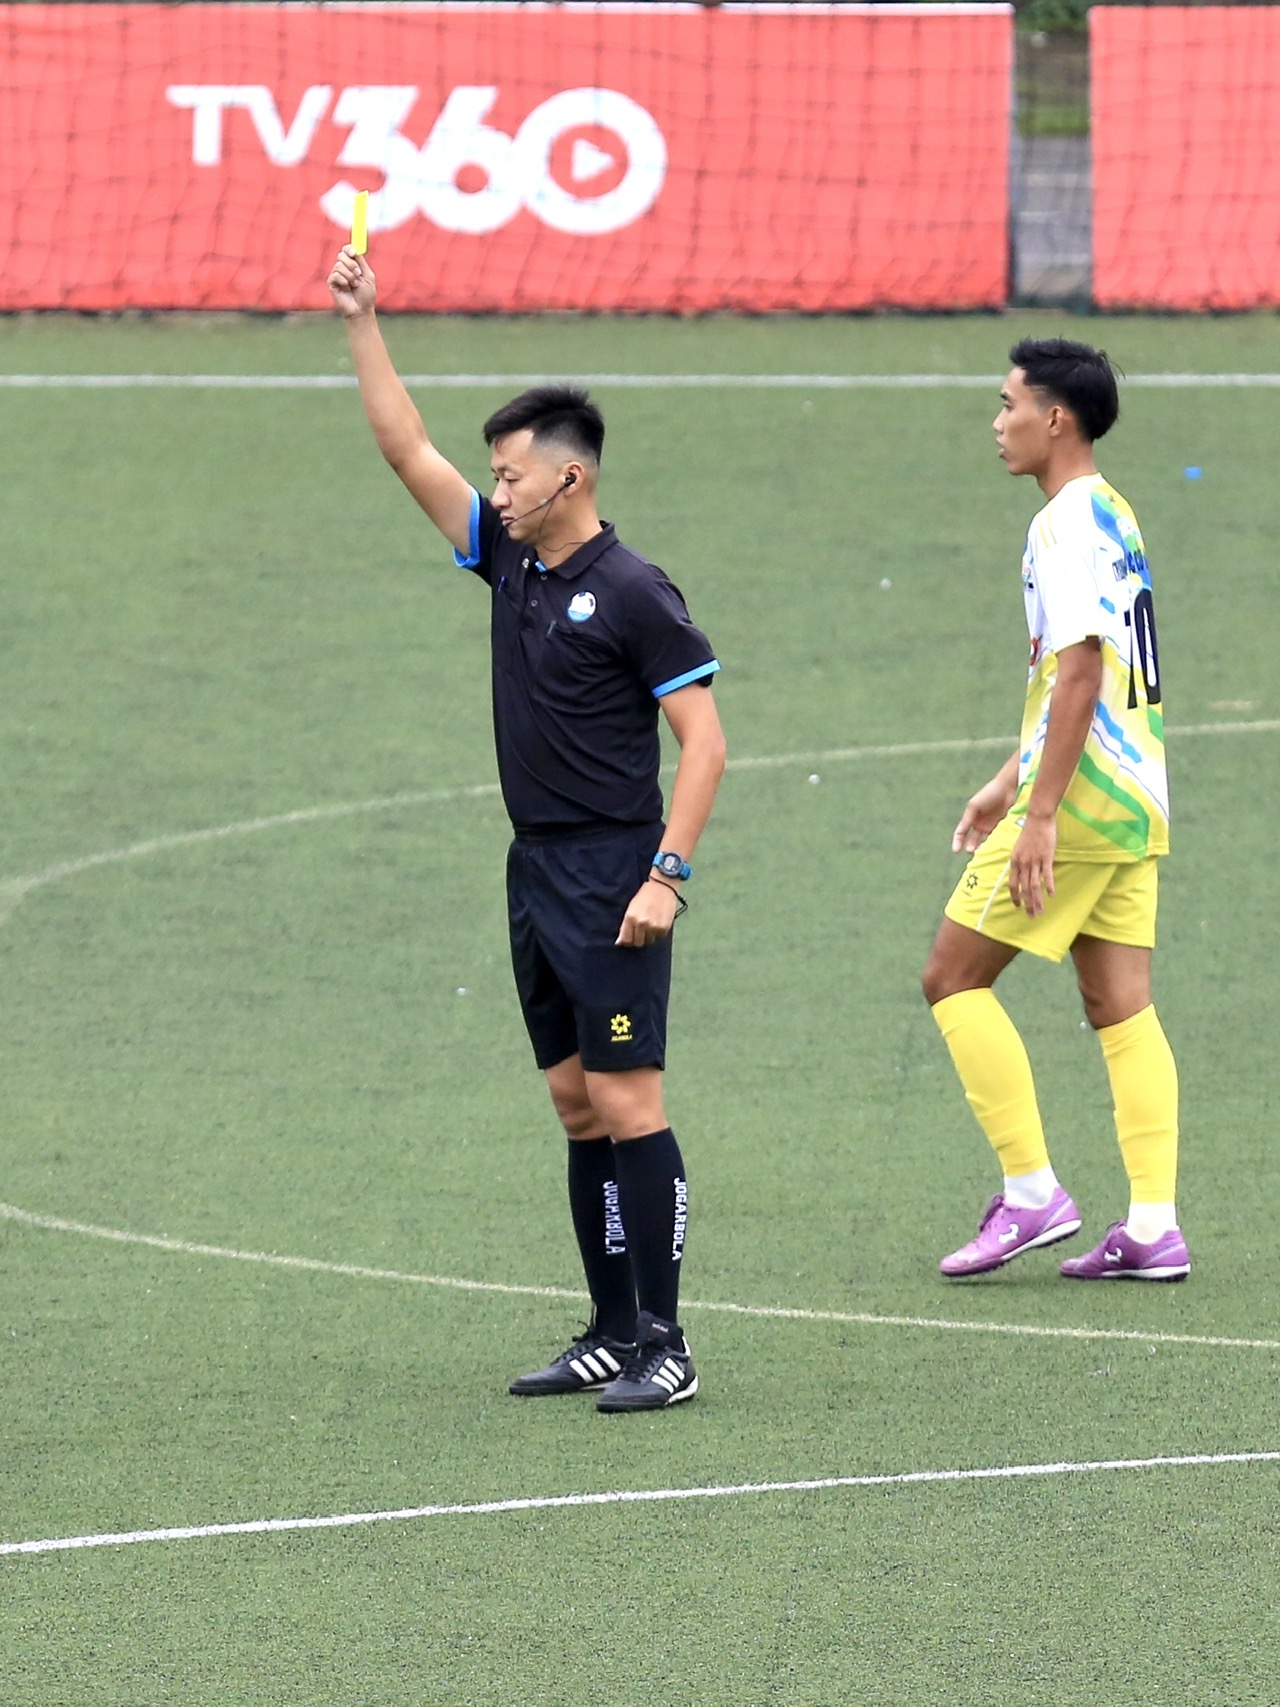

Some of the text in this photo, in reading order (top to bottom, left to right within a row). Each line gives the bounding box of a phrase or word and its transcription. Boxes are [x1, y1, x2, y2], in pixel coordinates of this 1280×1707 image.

[166, 84, 668, 234] TV360
[1124, 588, 1162, 709] 10
[673, 1177, 688, 1262] JOGARBOLA
